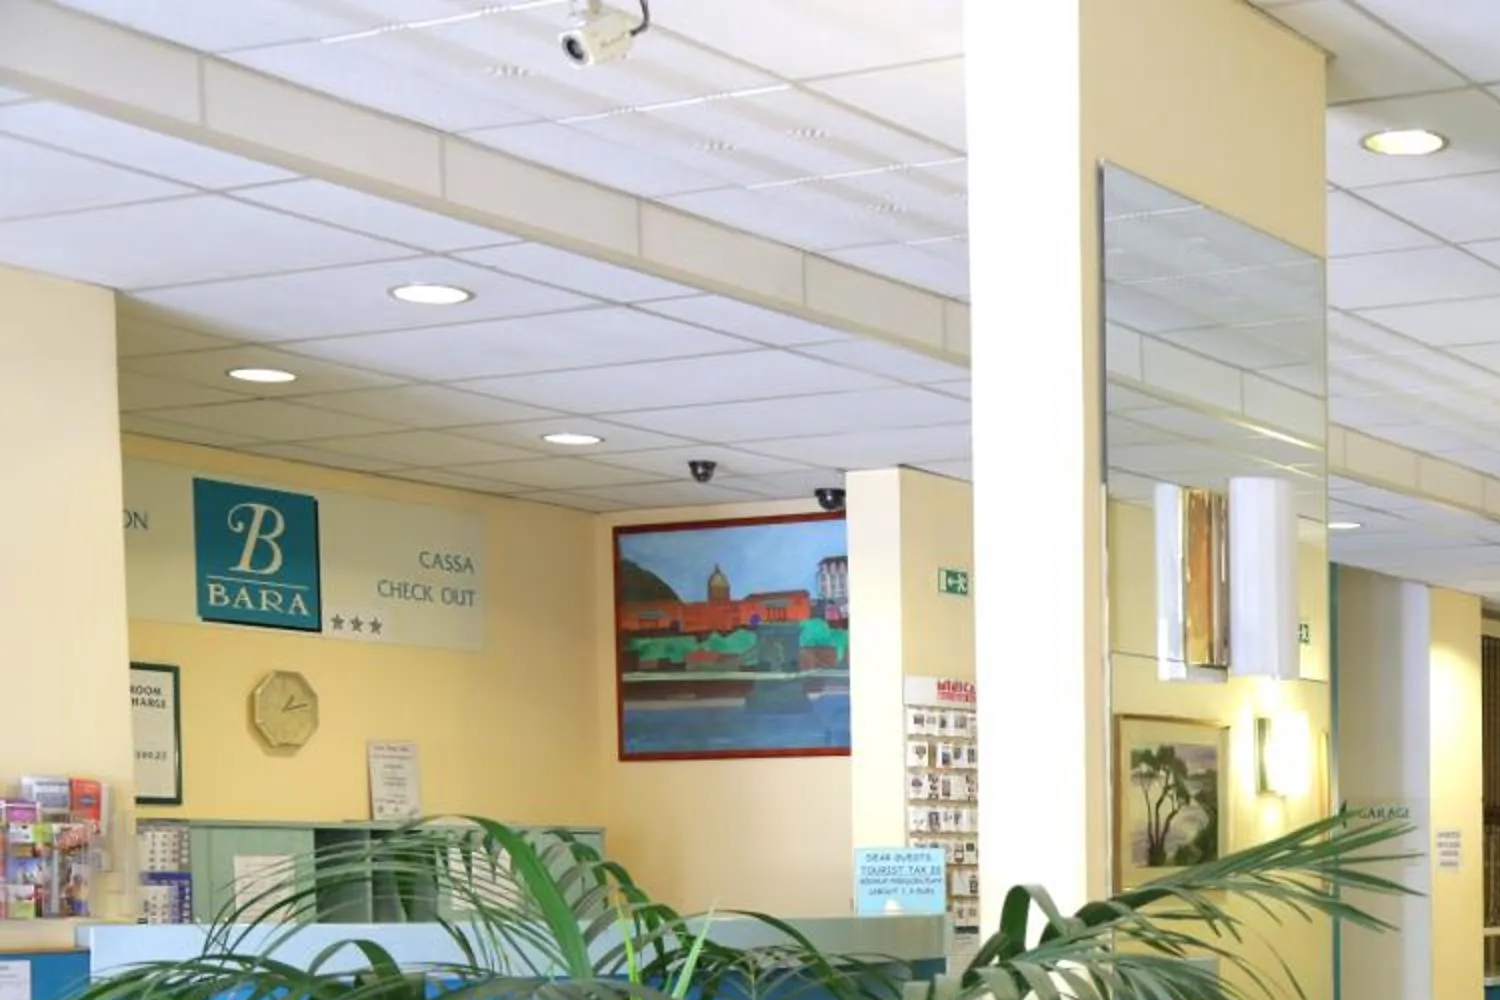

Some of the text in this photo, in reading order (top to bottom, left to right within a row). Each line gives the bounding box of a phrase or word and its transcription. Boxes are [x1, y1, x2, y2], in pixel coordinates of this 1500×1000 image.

[227, 503, 285, 575] B
[418, 551, 475, 575] CASSA
[208, 583, 310, 616] BARA
[377, 578, 476, 608] CHECK OUT
